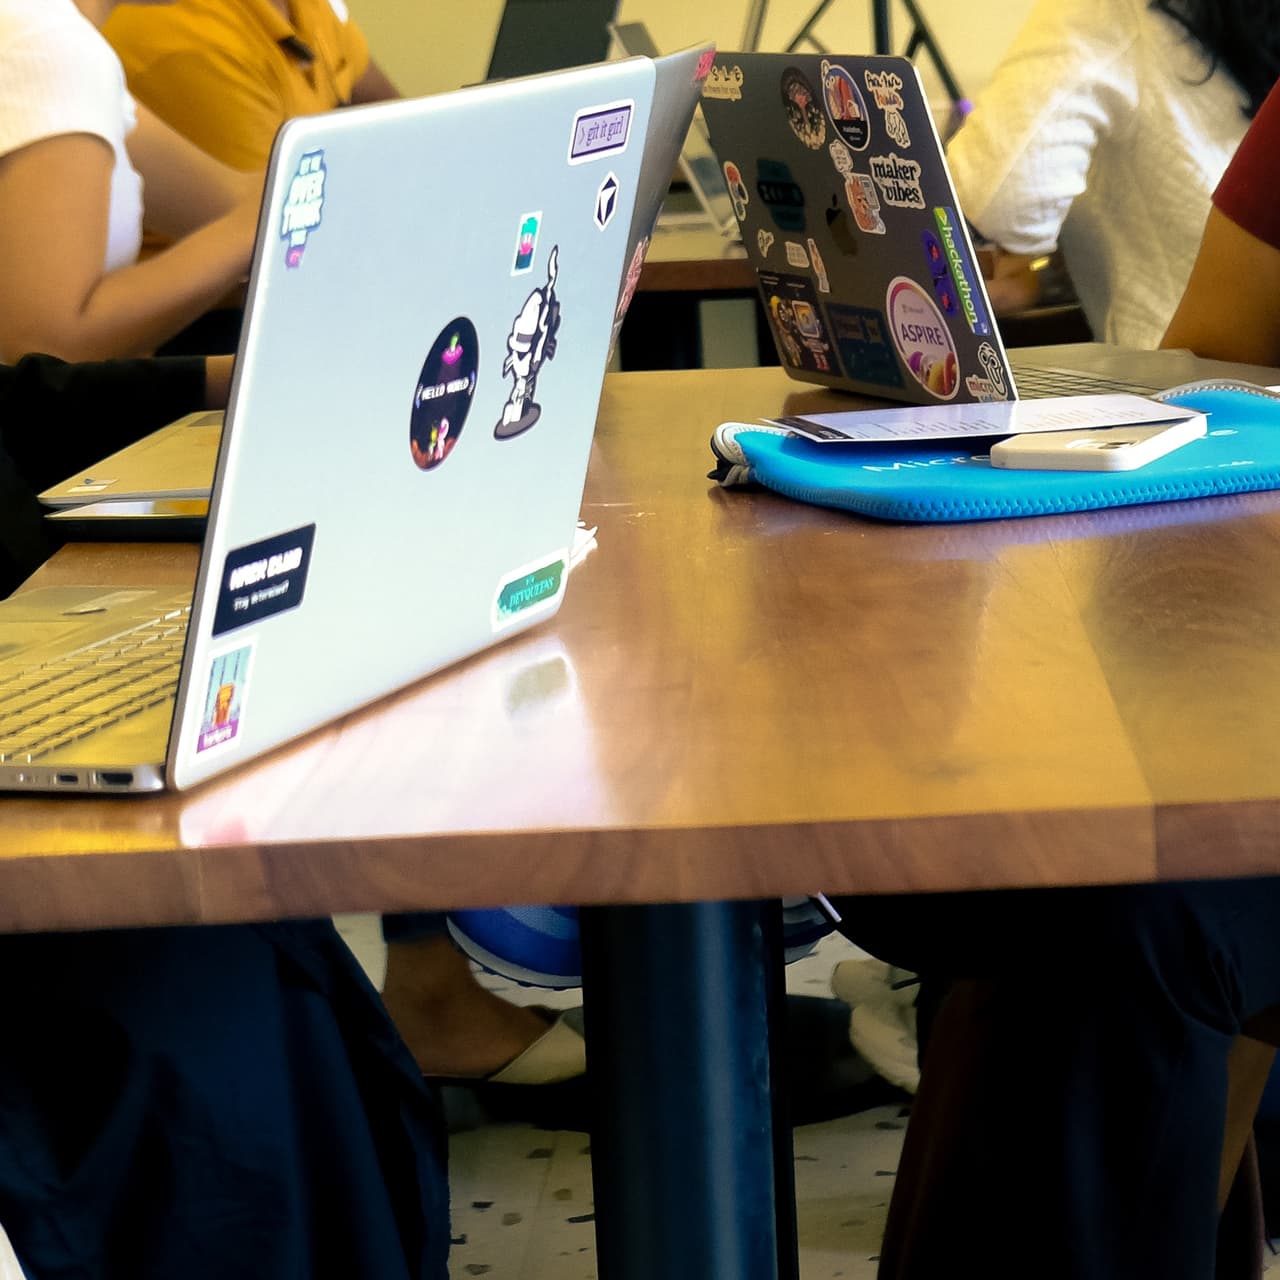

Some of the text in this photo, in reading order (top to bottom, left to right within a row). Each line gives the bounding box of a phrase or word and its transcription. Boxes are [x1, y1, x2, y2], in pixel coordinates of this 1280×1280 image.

[586, 122, 600, 147] git
[600, 120, 607, 138] it
[607, 115, 624, 141] girl
[873, 159, 916, 180] maker
[885, 181, 920, 202] vibes
[901, 323, 945, 346] ASPIRE
[422, 383, 445, 401] HELLO
[969, 380, 994, 393] micro
[862, 454, 991, 472] Micro
